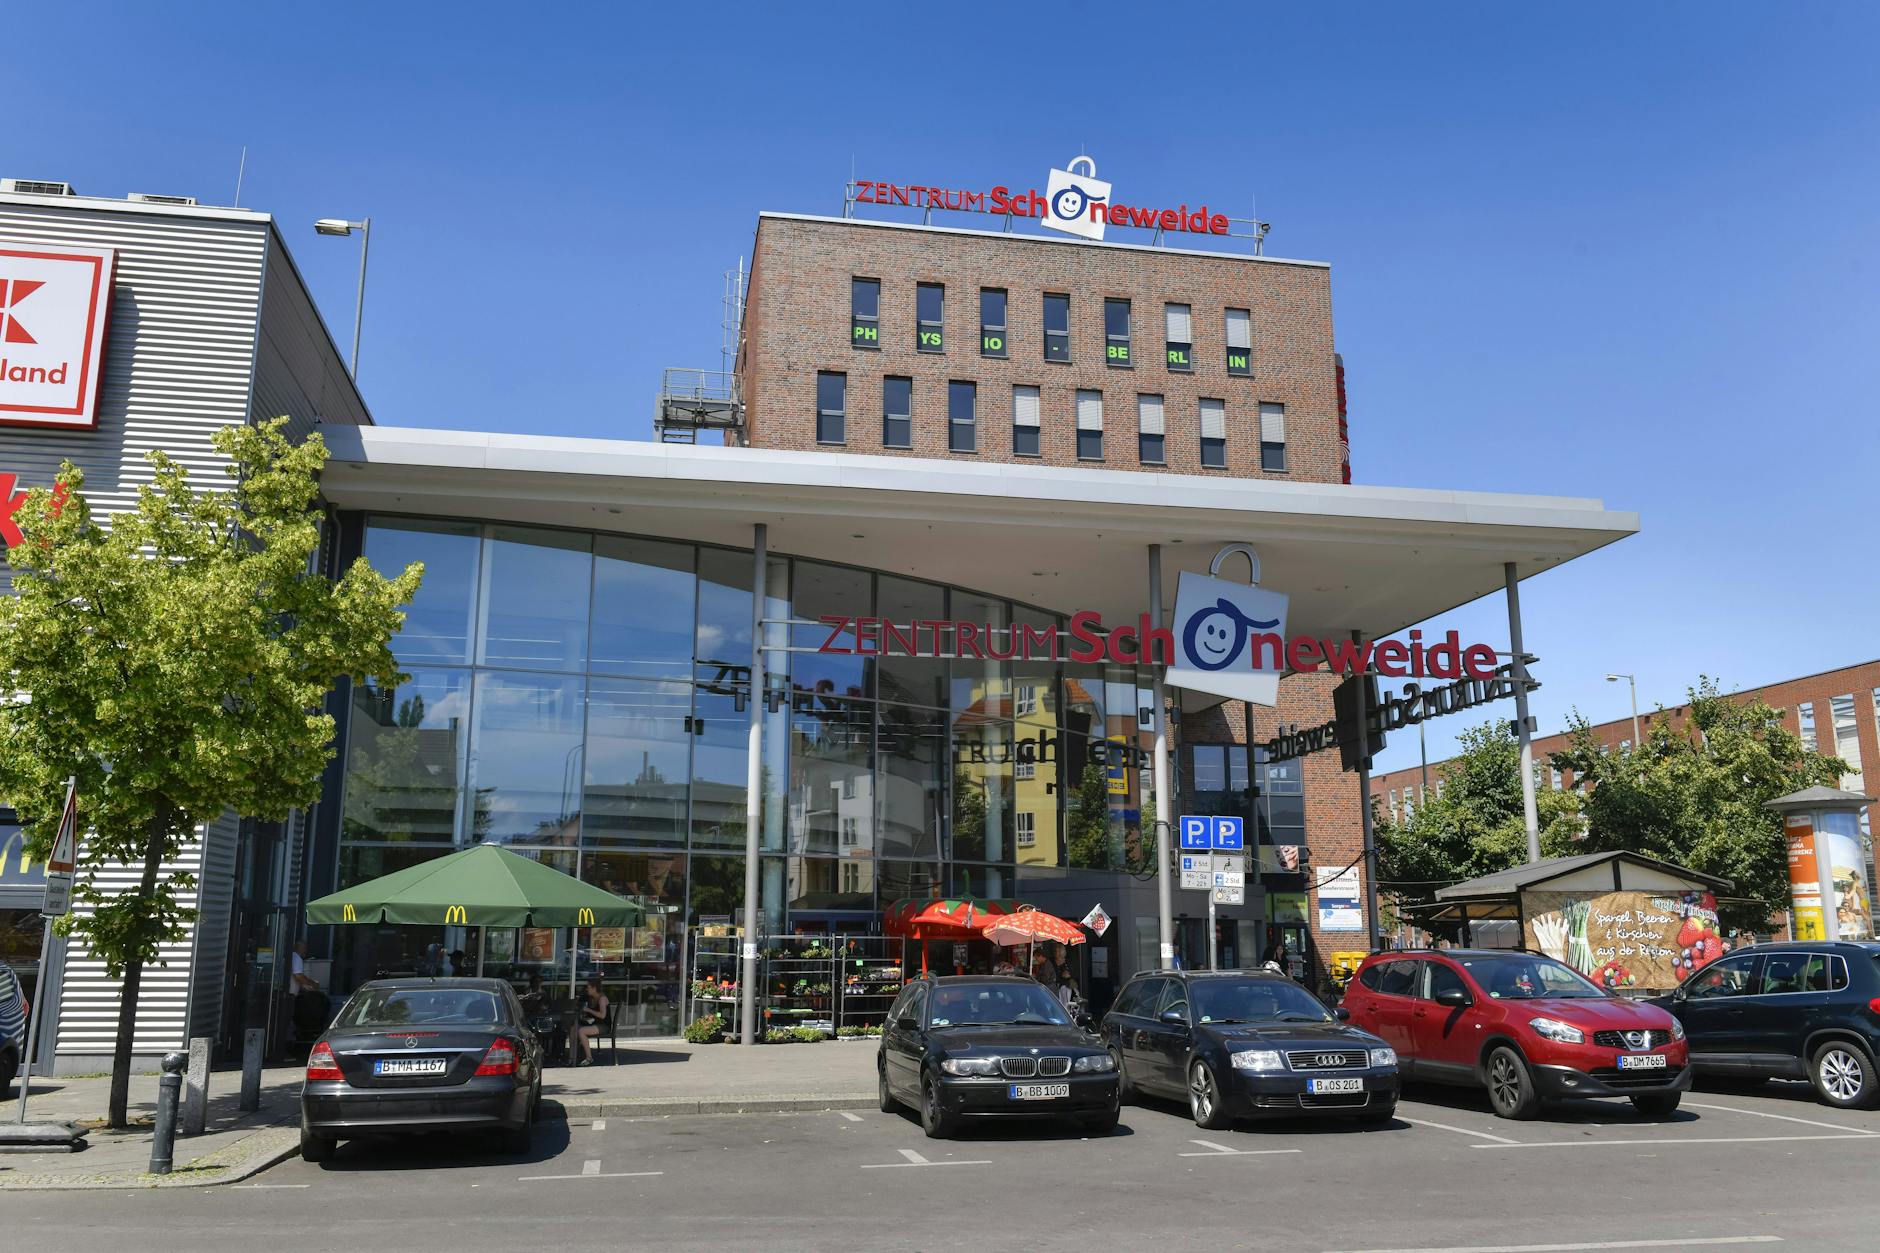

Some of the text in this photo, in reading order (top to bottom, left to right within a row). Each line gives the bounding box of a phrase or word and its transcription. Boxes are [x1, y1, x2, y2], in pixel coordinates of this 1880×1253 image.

[856, 181, 984, 212] ZENTRUM
[855, 327, 877, 341] PH
[920, 332, 942, 346] YS
[984, 336, 1002, 351] IO
[1108, 346, 1128, 360] BE
[1168, 350, 1188, 364] RL
[1228, 355, 1246, 368] IN
[819, 614, 1058, 662] ZENTRUM
[1187, 819, 1205, 845] P
[1219, 820, 1236, 845] P
[1595, 909, 1675, 927] Spargel, Beeren
[1616, 928, 1662, 941] Kirschen
[1597, 942, 1676, 960] aus der Region
[383, 1060, 444, 1072] B MA 1167
[1623, 1056, 1665, 1067] B DM 7665
[1016, 1087, 1023, 1097] B
[1030, 1087, 1043, 1096] BB
[1316, 1081, 1323, 1090] B
